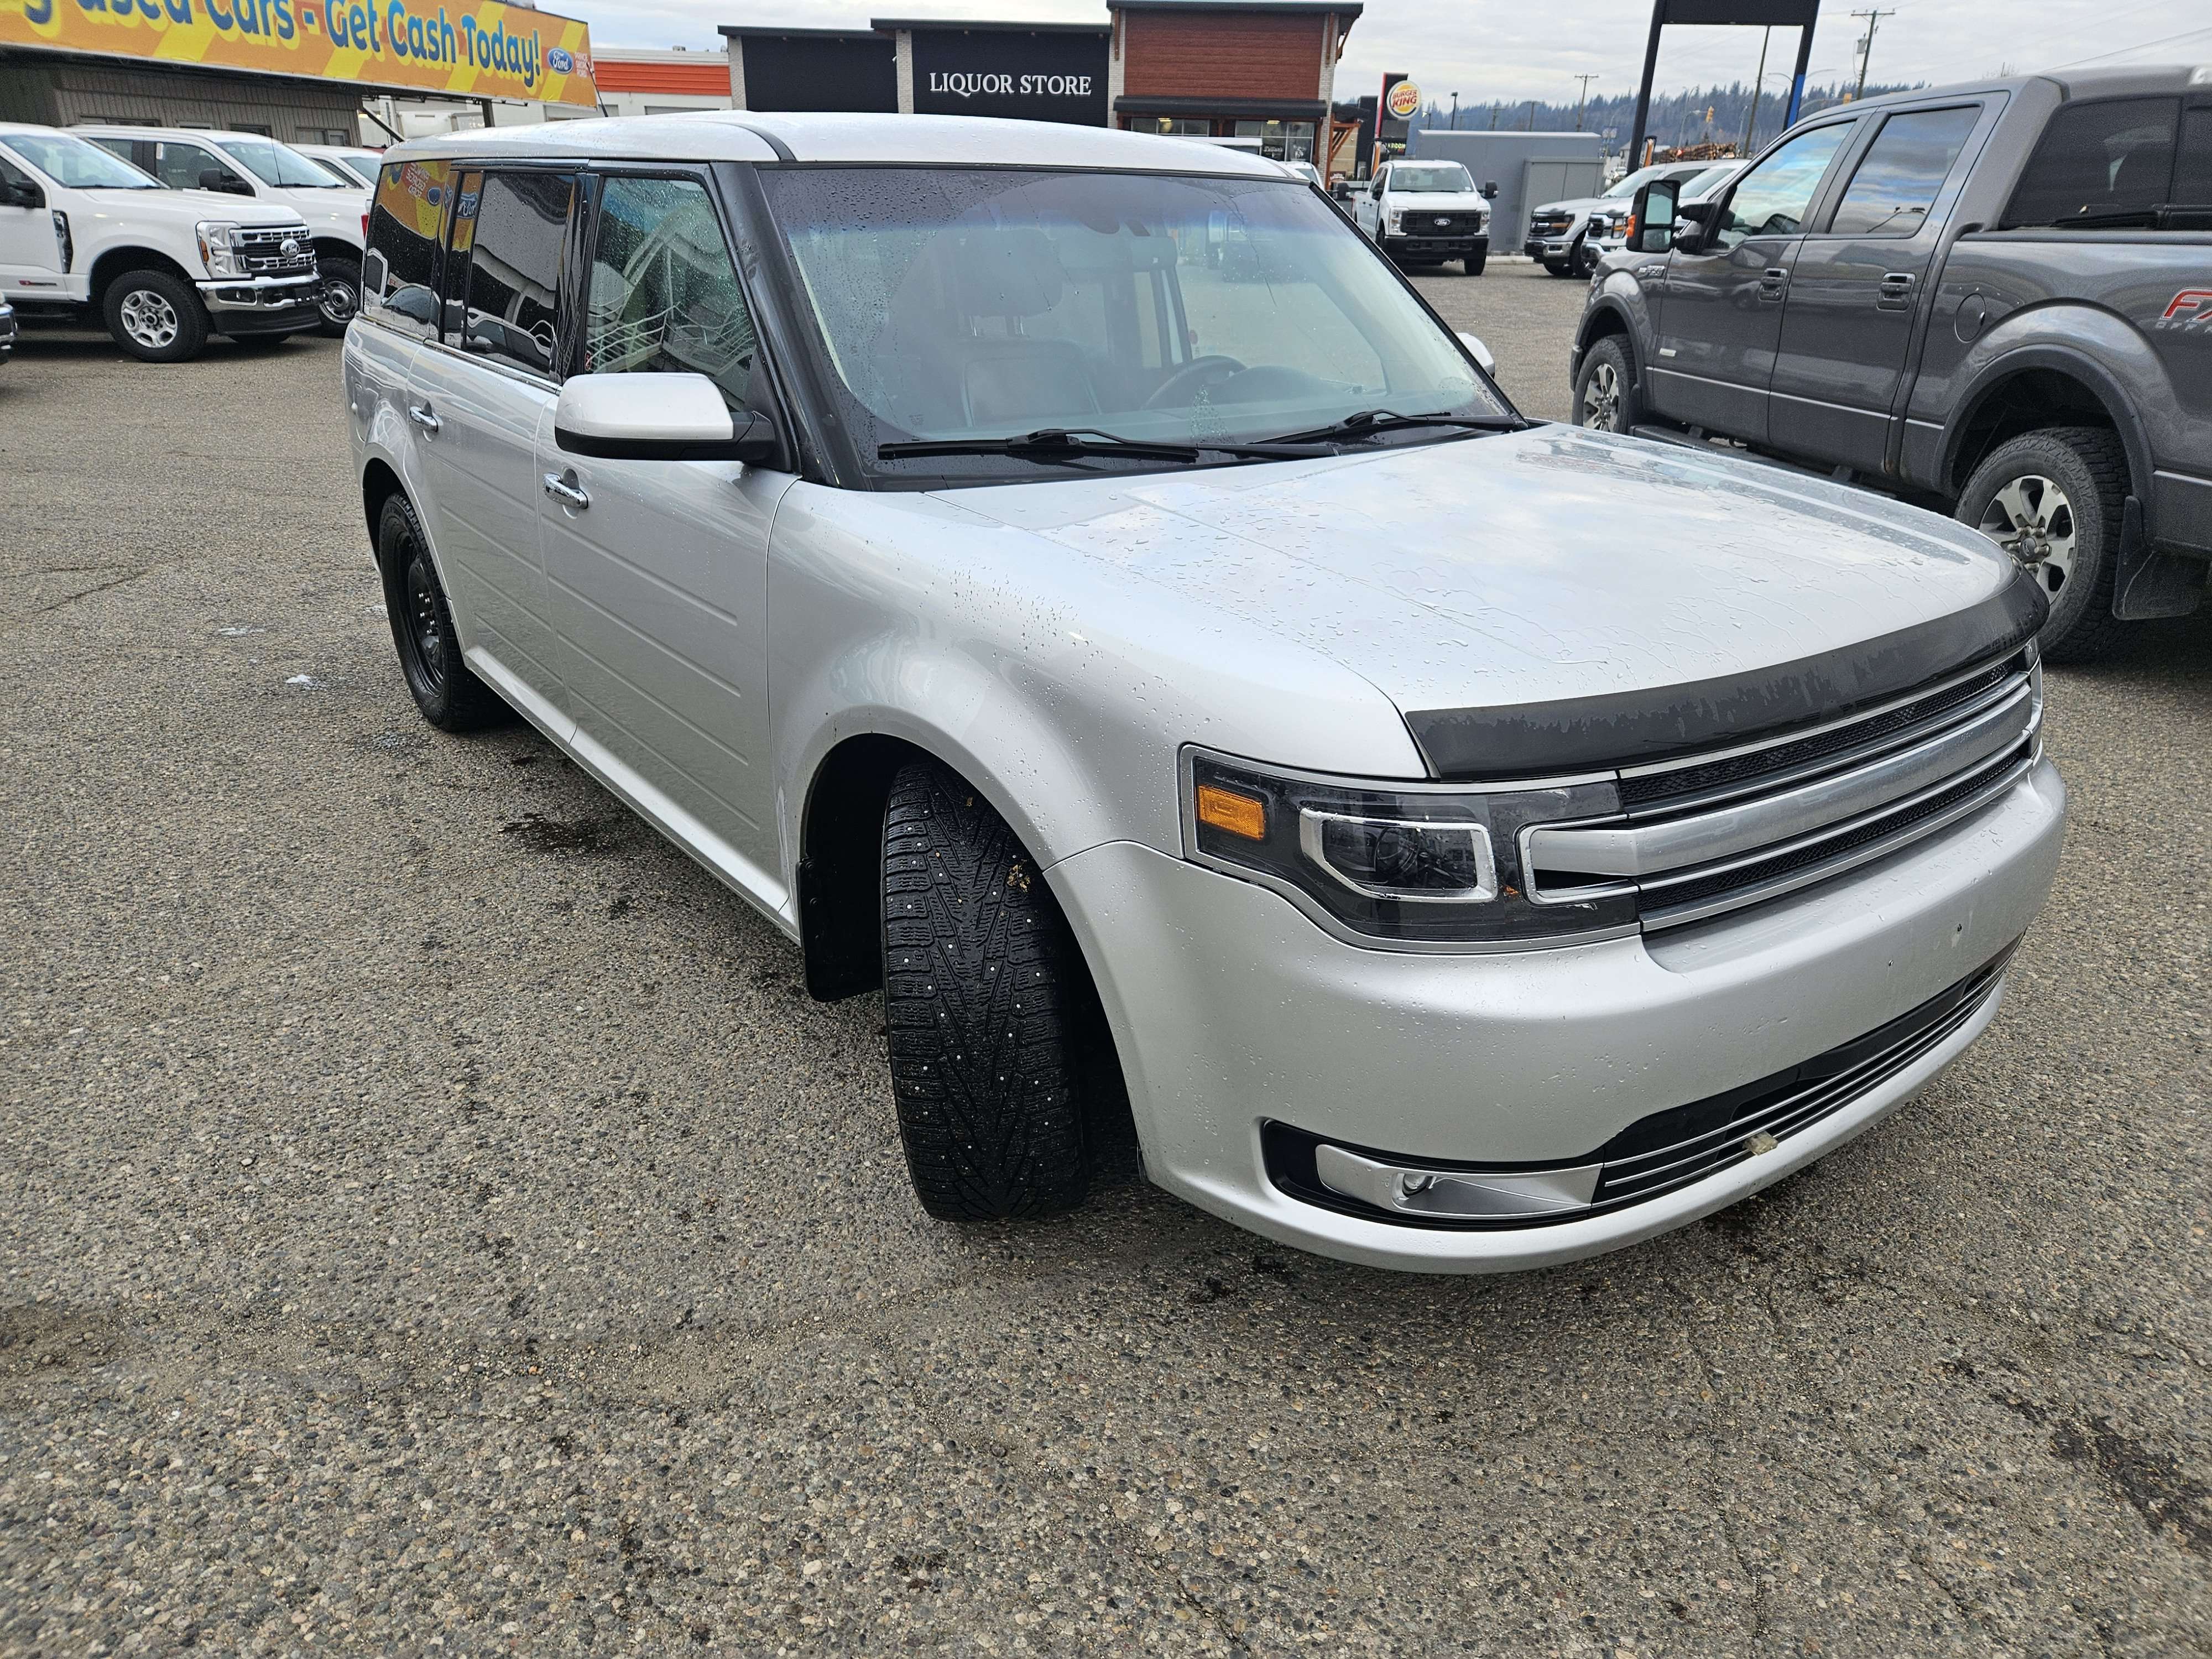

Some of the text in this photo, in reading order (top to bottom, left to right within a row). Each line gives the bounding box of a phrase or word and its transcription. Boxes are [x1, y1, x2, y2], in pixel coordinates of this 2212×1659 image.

[206, 0, 294, 39] Cars
[325, 0, 380, 53] Get
[388, 0, 456, 64] Cash
[461, 14, 540, 87] Today!
[552, 50, 570, 70] Ford
[929, 72, 1092, 97] LIQUOR STORE
[1393, 90, 1417, 98] BURGER
[1392, 96, 1417, 107] KING
